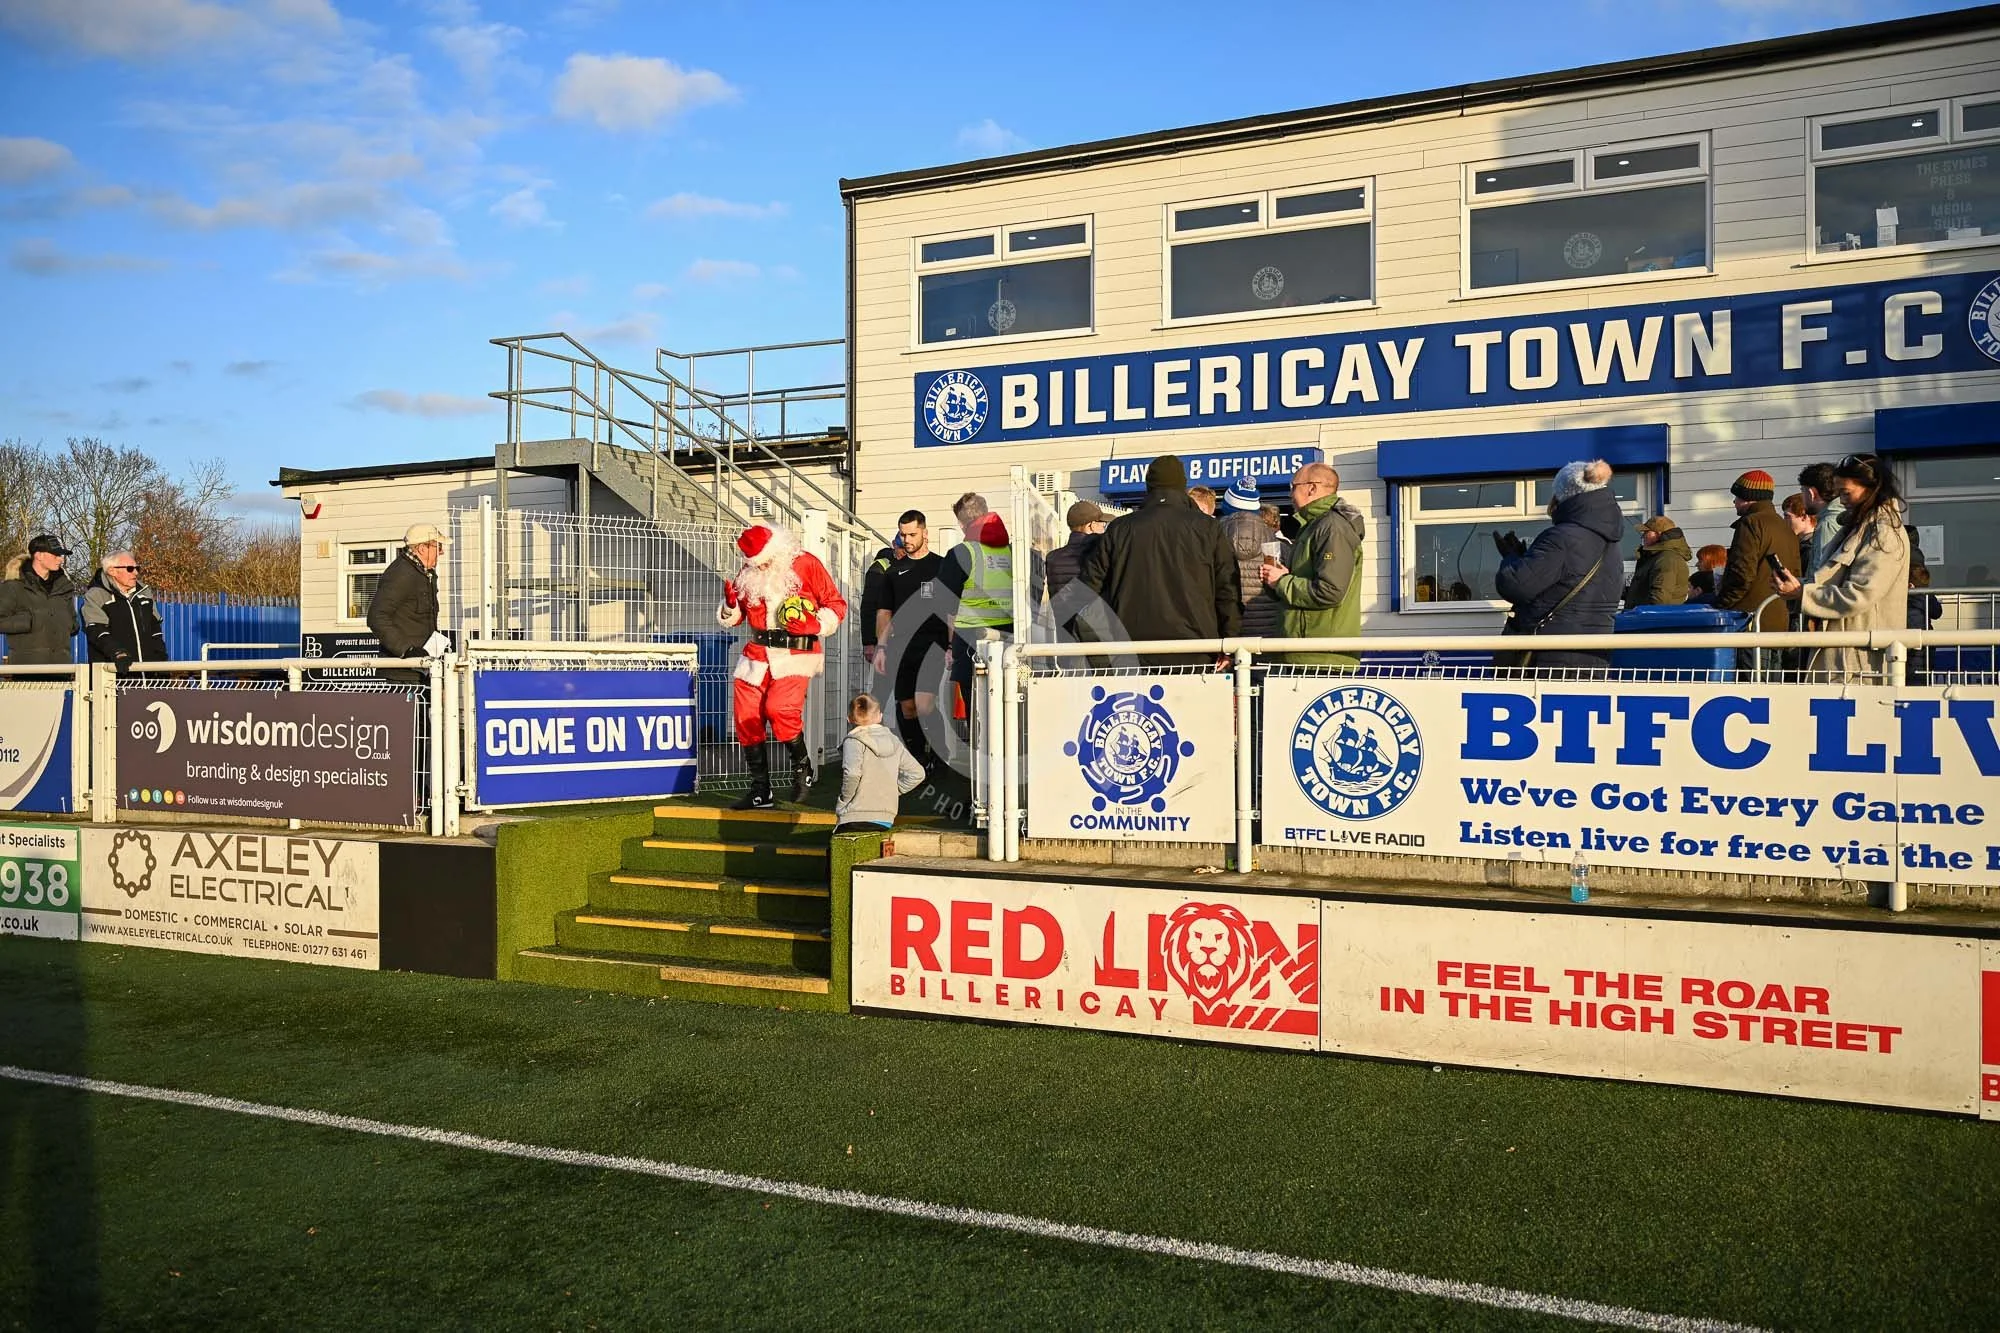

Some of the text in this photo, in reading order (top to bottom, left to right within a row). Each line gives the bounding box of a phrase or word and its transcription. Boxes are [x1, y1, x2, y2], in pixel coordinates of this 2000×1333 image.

[1001, 337, 1425, 430] BILLERICAY
[1455, 310, 1732, 394] TOWN
[926, 372, 987, 409] BILLERICAY
[929, 411, 986, 441] TOWN F.C.
[1190, 459, 1203, 480] &
[1208, 454, 1303, 479] OFFICIALS
[322, 667, 377, 677] BILLERICAY
[186, 711, 389, 759] wisdomdesign
[485, 715, 693, 757] COME ON YOU
[1095, 712, 1162, 749] BILLERICAY
[1295, 689, 1420, 756] BILLERICAY
[1461, 692, 1772, 770] BTFC
[186, 761, 388, 788] branding & design specialists
[1099, 755, 1161, 785] TOWN F.C.
[188, 795, 209, 805] Follow
[219, 797, 226, 805] at
[227, 797, 284, 810] wisdomdesignuk
[1301, 766, 1417, 816] TOWN F.C.
[1460, 777, 1985, 827] We've Got Every Game
[1070, 814, 1191, 832] COMMUNITY
[1115, 807, 1142, 816] IN THE
[9, 833, 65, 848] Specialists
[171, 833, 343, 878] AXELEY
[1285, 827, 1326, 840] BTFC
[1376, 832, 1425, 847] RADIO
[1459, 821, 1571, 849] Listen
[1581, 827, 1650, 852] live
[1660, 831, 1719, 857] for
[1728, 834, 1811, 861] free
[1822, 840, 1889, 866] via
[1901, 843, 1973, 870] the
[1, 860, 69, 907] 938
[170, 874, 343, 911] ELECTRICAL
[125, 909, 323, 937] DOMESTIC COMMERCIAL SOLAR
[891, 896, 1064, 979] RED
[91, 925, 367, 960] WWW.AXELEYELECTRICAL.CO.UK TELEPHONE: 01277 631 461
[890, 974, 1168, 1021] BILLERICAY
[1437, 960, 1830, 1016] FEEL THE ROAR
[1380, 986, 1902, 1054] IN THE HIGH STREET
